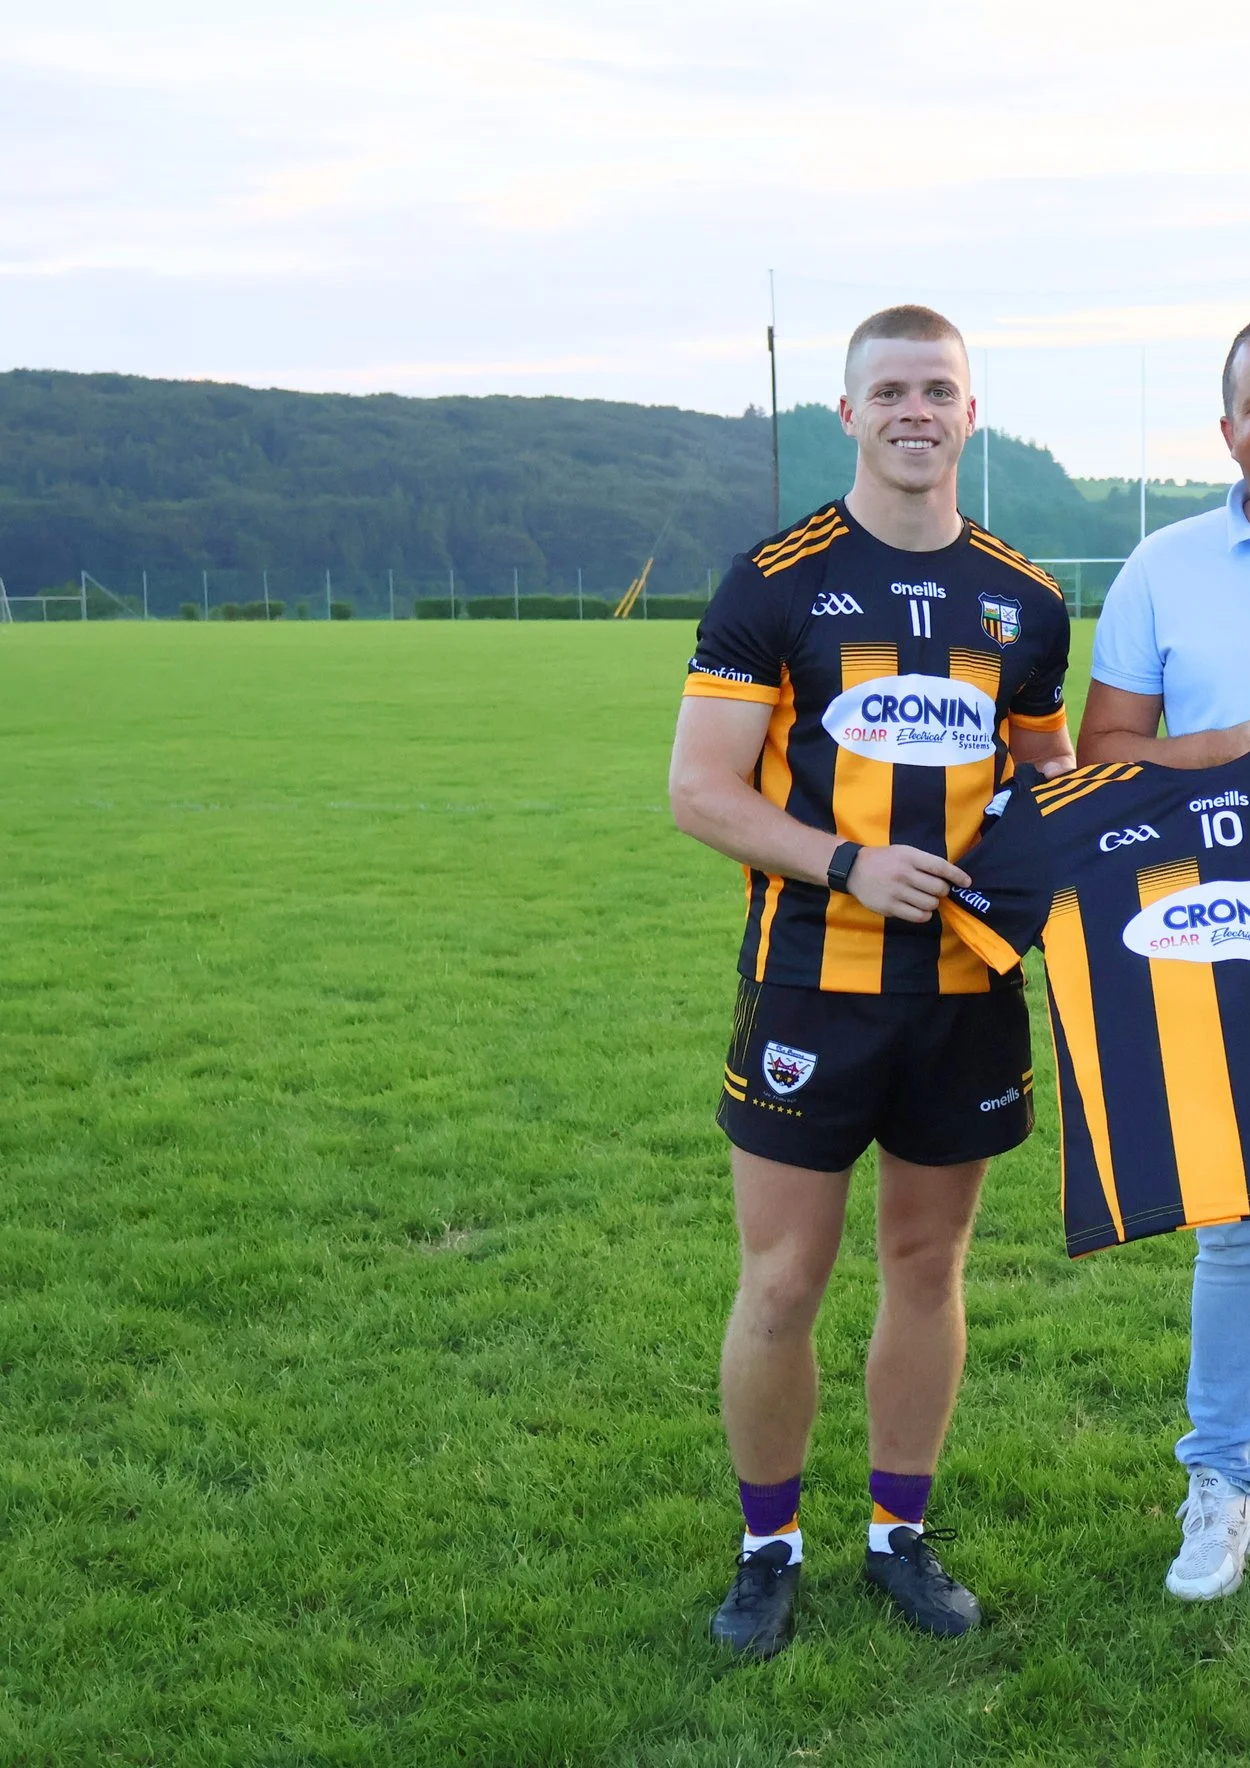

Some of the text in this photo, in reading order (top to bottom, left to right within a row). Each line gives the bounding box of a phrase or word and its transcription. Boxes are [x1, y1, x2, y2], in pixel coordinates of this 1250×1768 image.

[909, 599, 932, 639] 11
[861, 693, 982, 731] CRONIN
[843, 727, 888, 742] SOLAR
[896, 727, 948, 743] Electrical
[958, 740, 990, 750] Systems
[1201, 810, 1243, 849] 10
[1150, 933, 1200, 952] SOLAR
